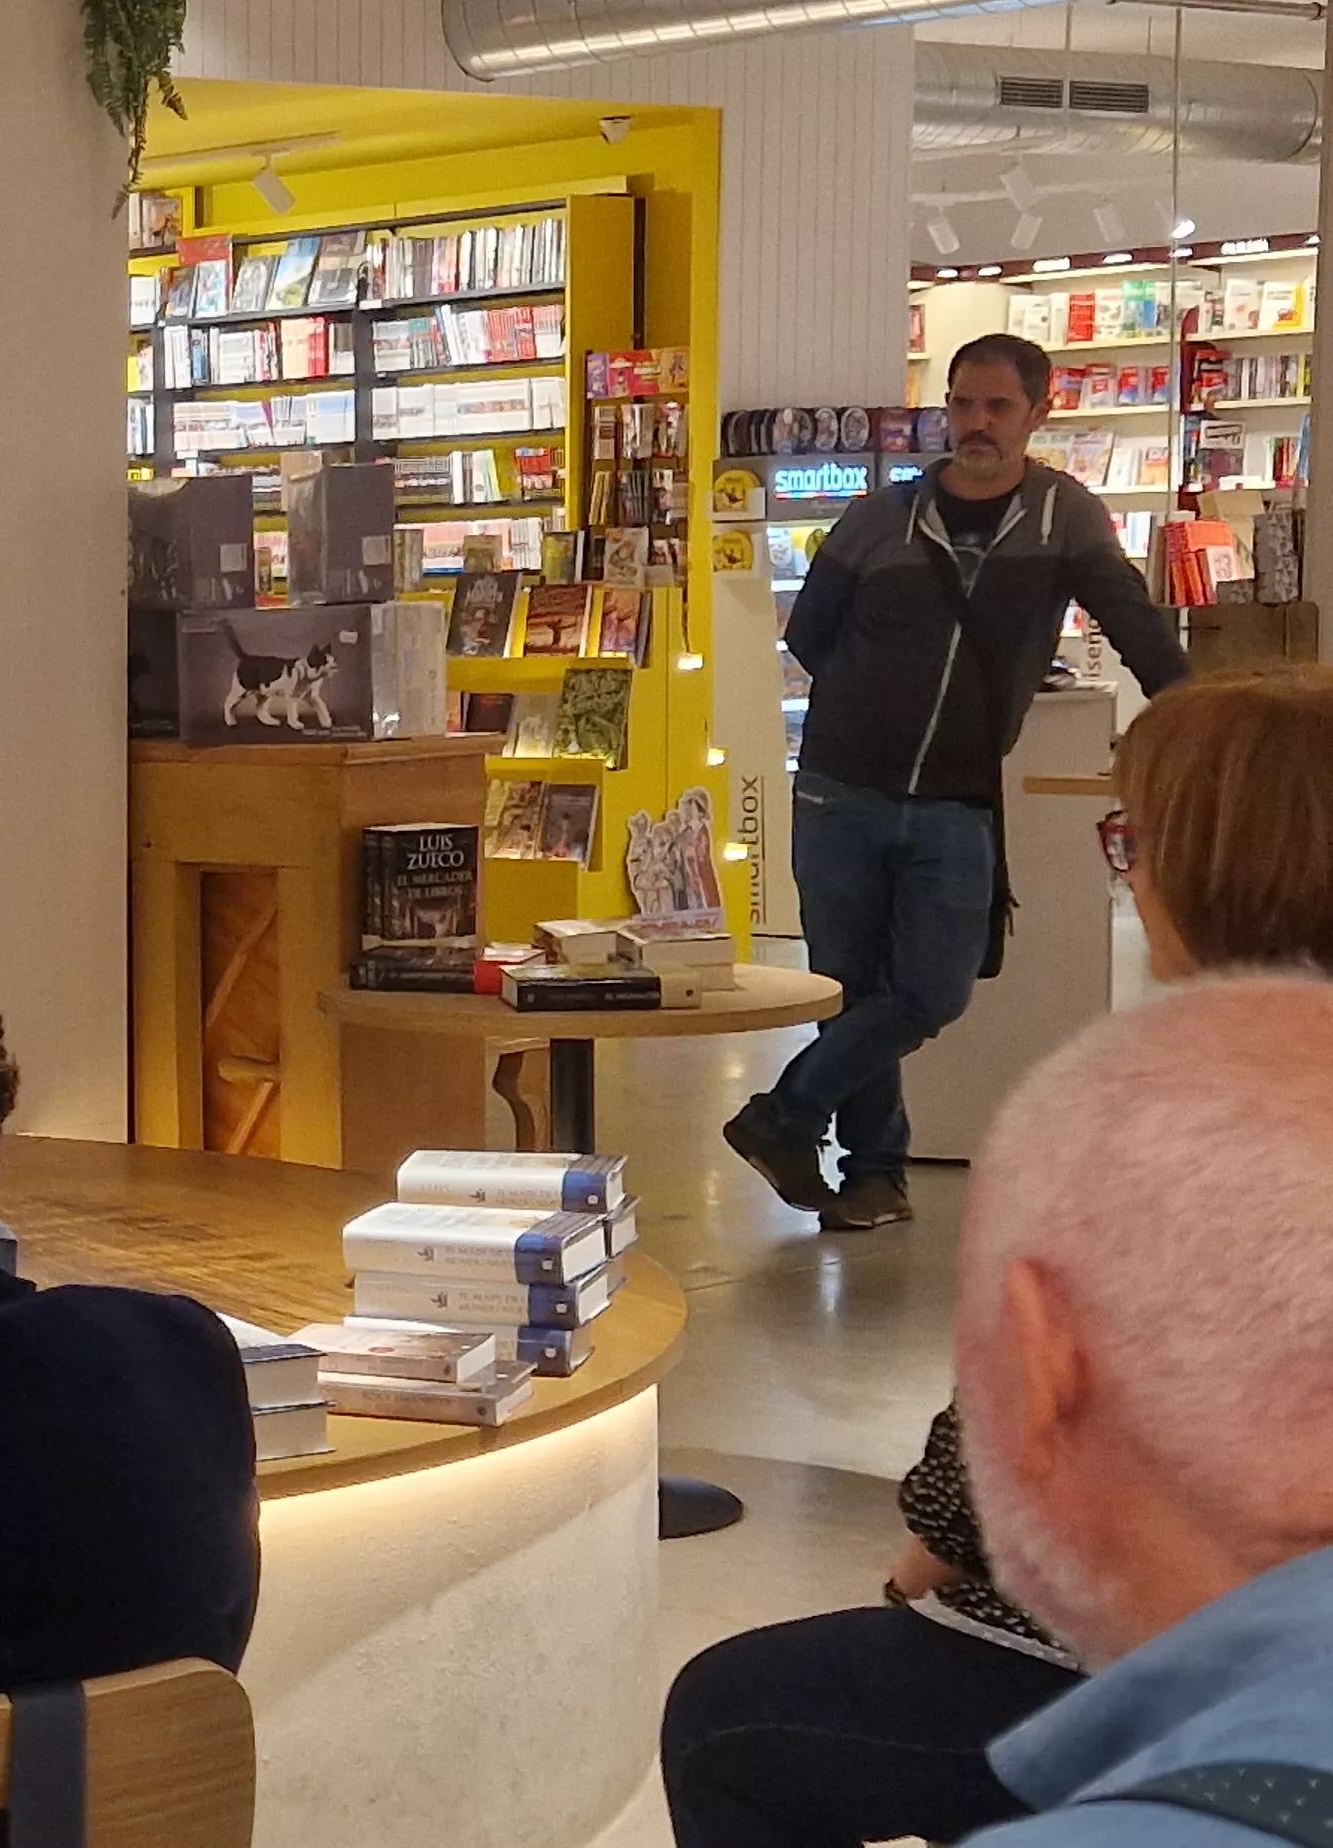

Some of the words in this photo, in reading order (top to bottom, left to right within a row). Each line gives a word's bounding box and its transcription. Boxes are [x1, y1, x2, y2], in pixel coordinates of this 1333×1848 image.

[775, 462, 868, 492] smartbox
[419, 833, 453, 852] LUIS
[406, 850, 465, 870] ZUECO
